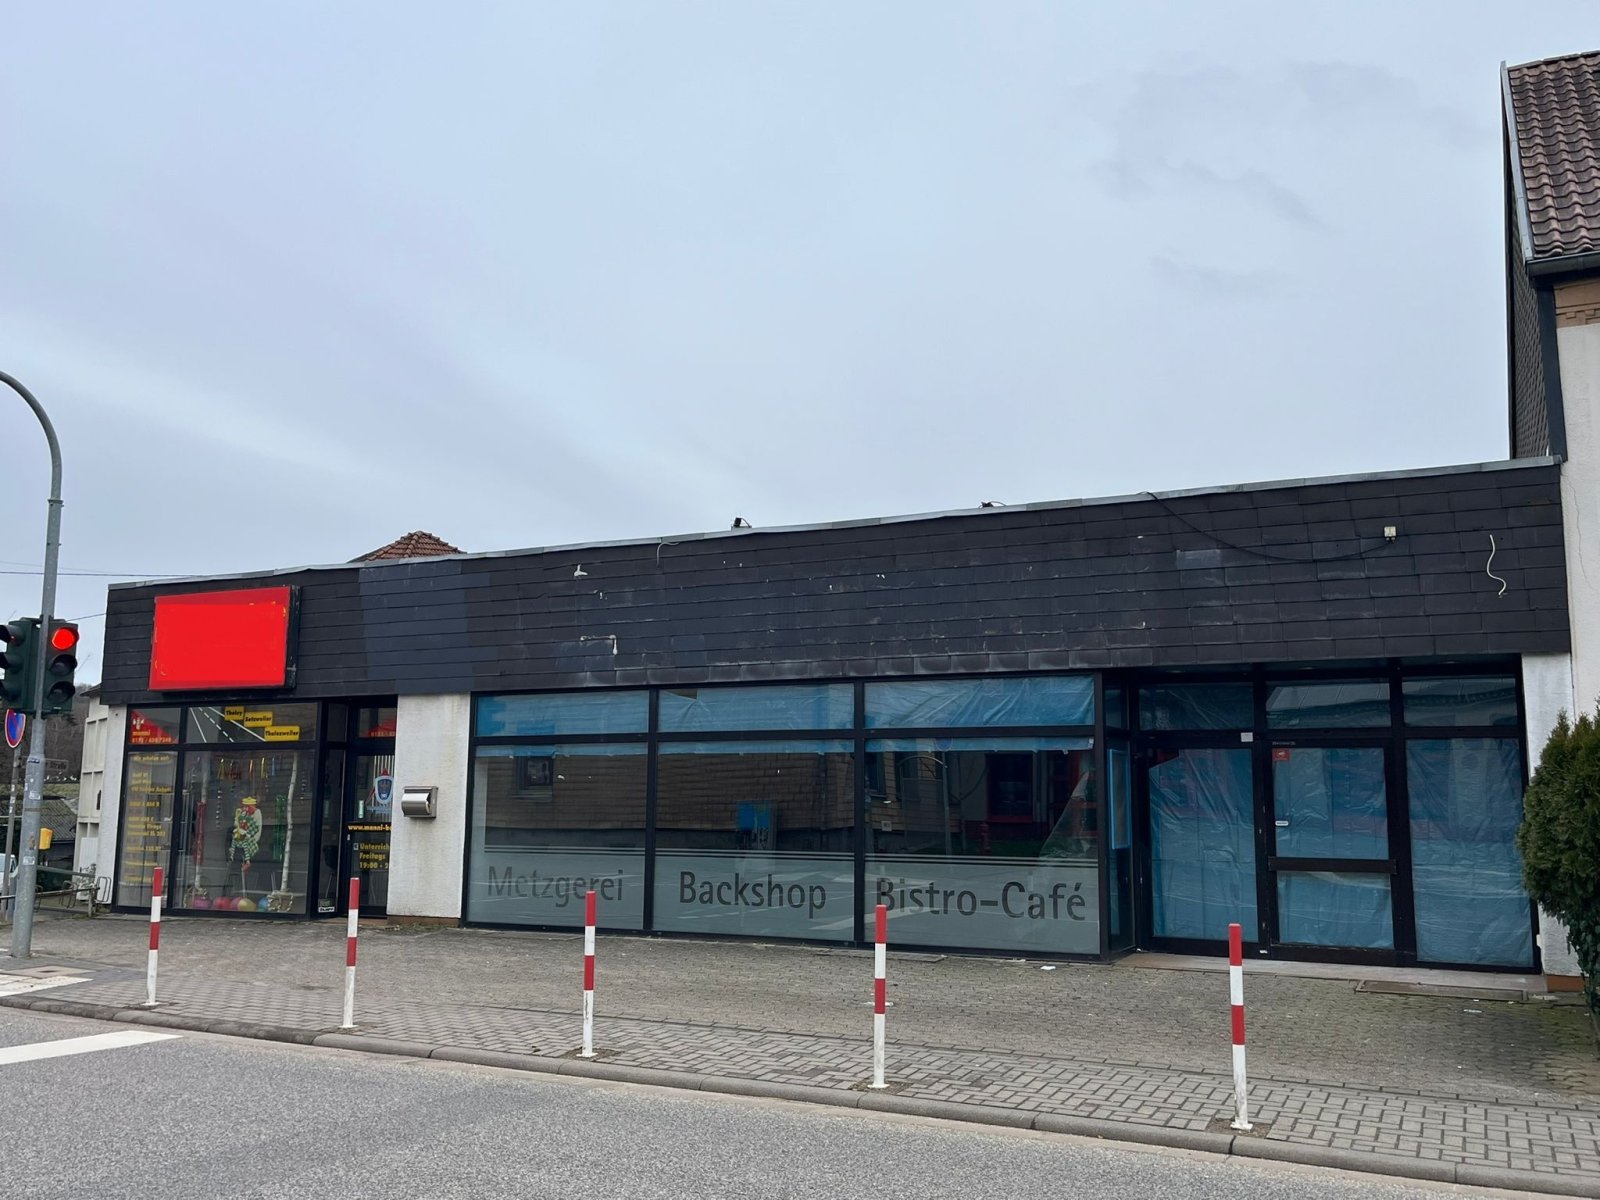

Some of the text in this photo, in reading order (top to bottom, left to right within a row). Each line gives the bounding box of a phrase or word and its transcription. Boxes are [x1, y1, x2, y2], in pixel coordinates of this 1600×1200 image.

[359, 861, 378, 869] 19:00
[487, 865, 1086, 921] Metzgerei Backshop Bistro-Café
